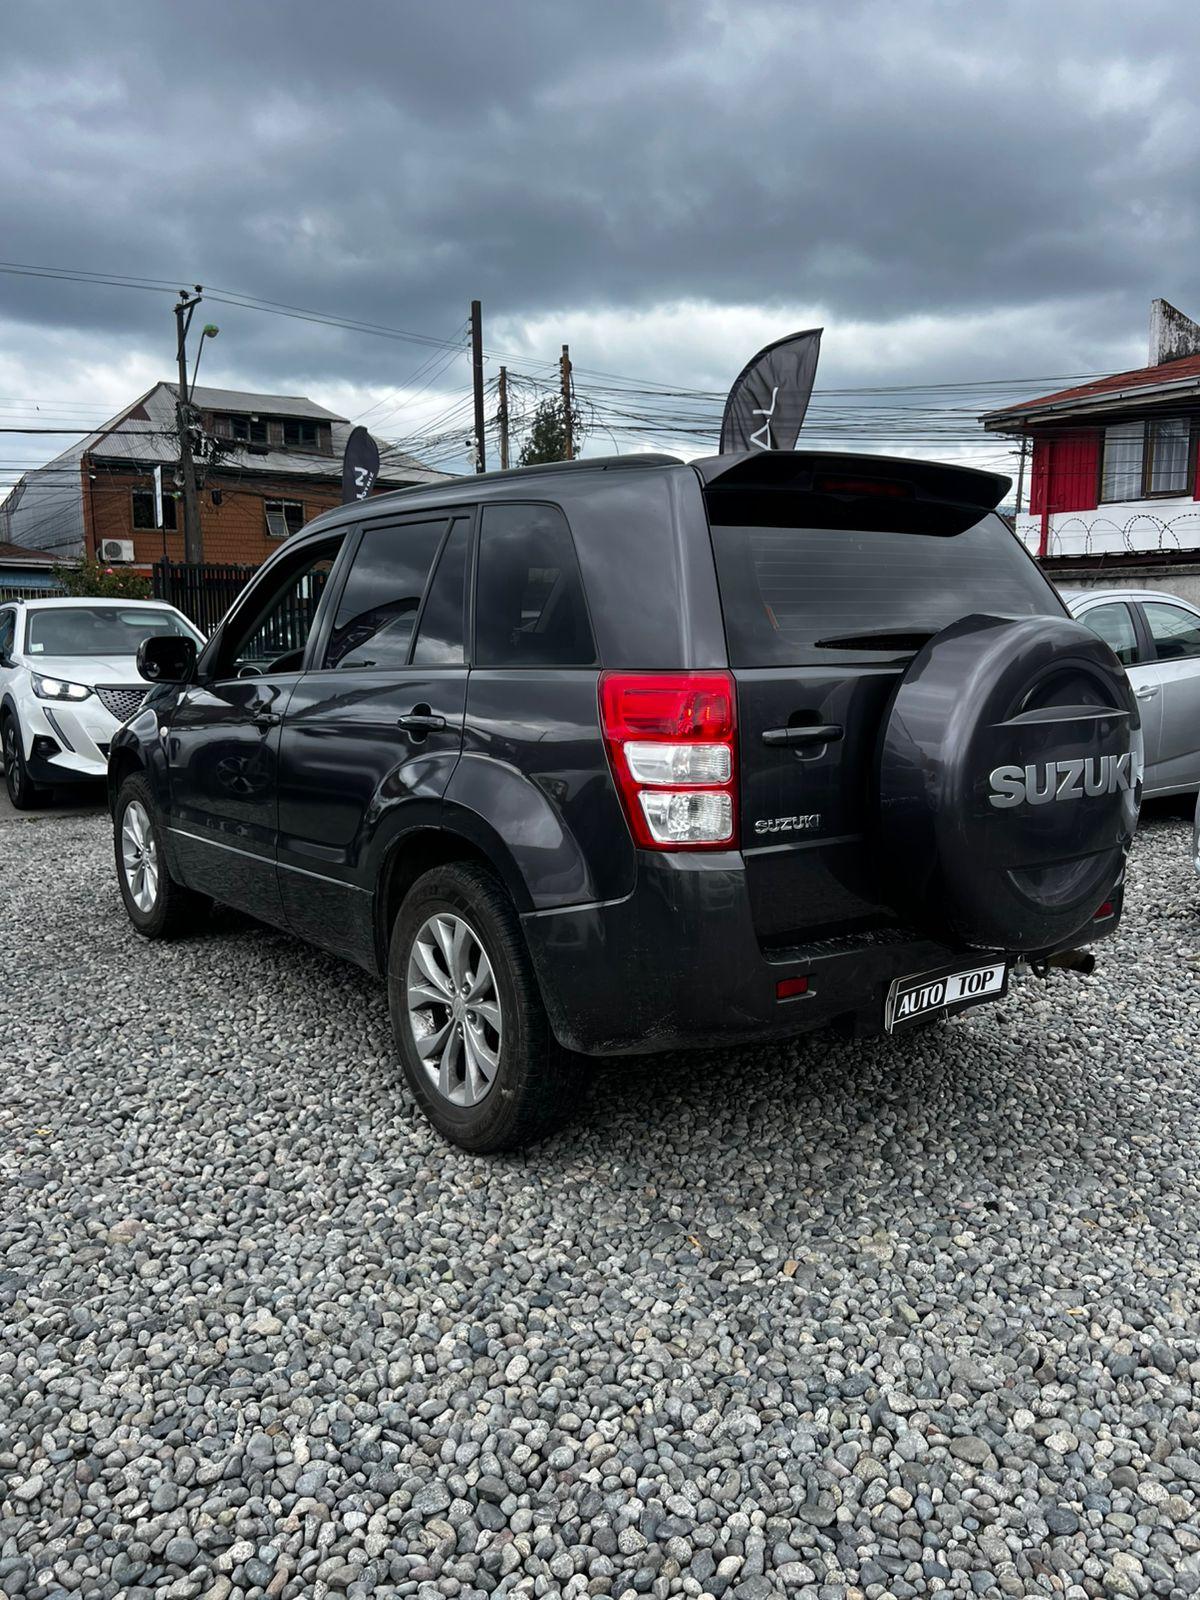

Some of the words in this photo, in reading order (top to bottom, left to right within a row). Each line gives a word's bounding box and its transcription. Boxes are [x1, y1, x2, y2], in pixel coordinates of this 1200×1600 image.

[988, 751, 1137, 809] SUZUKI
[755, 814, 820, 834] SUZUKI
[898, 983, 944, 1017] AUTO
[958, 970, 995, 995] TOP
